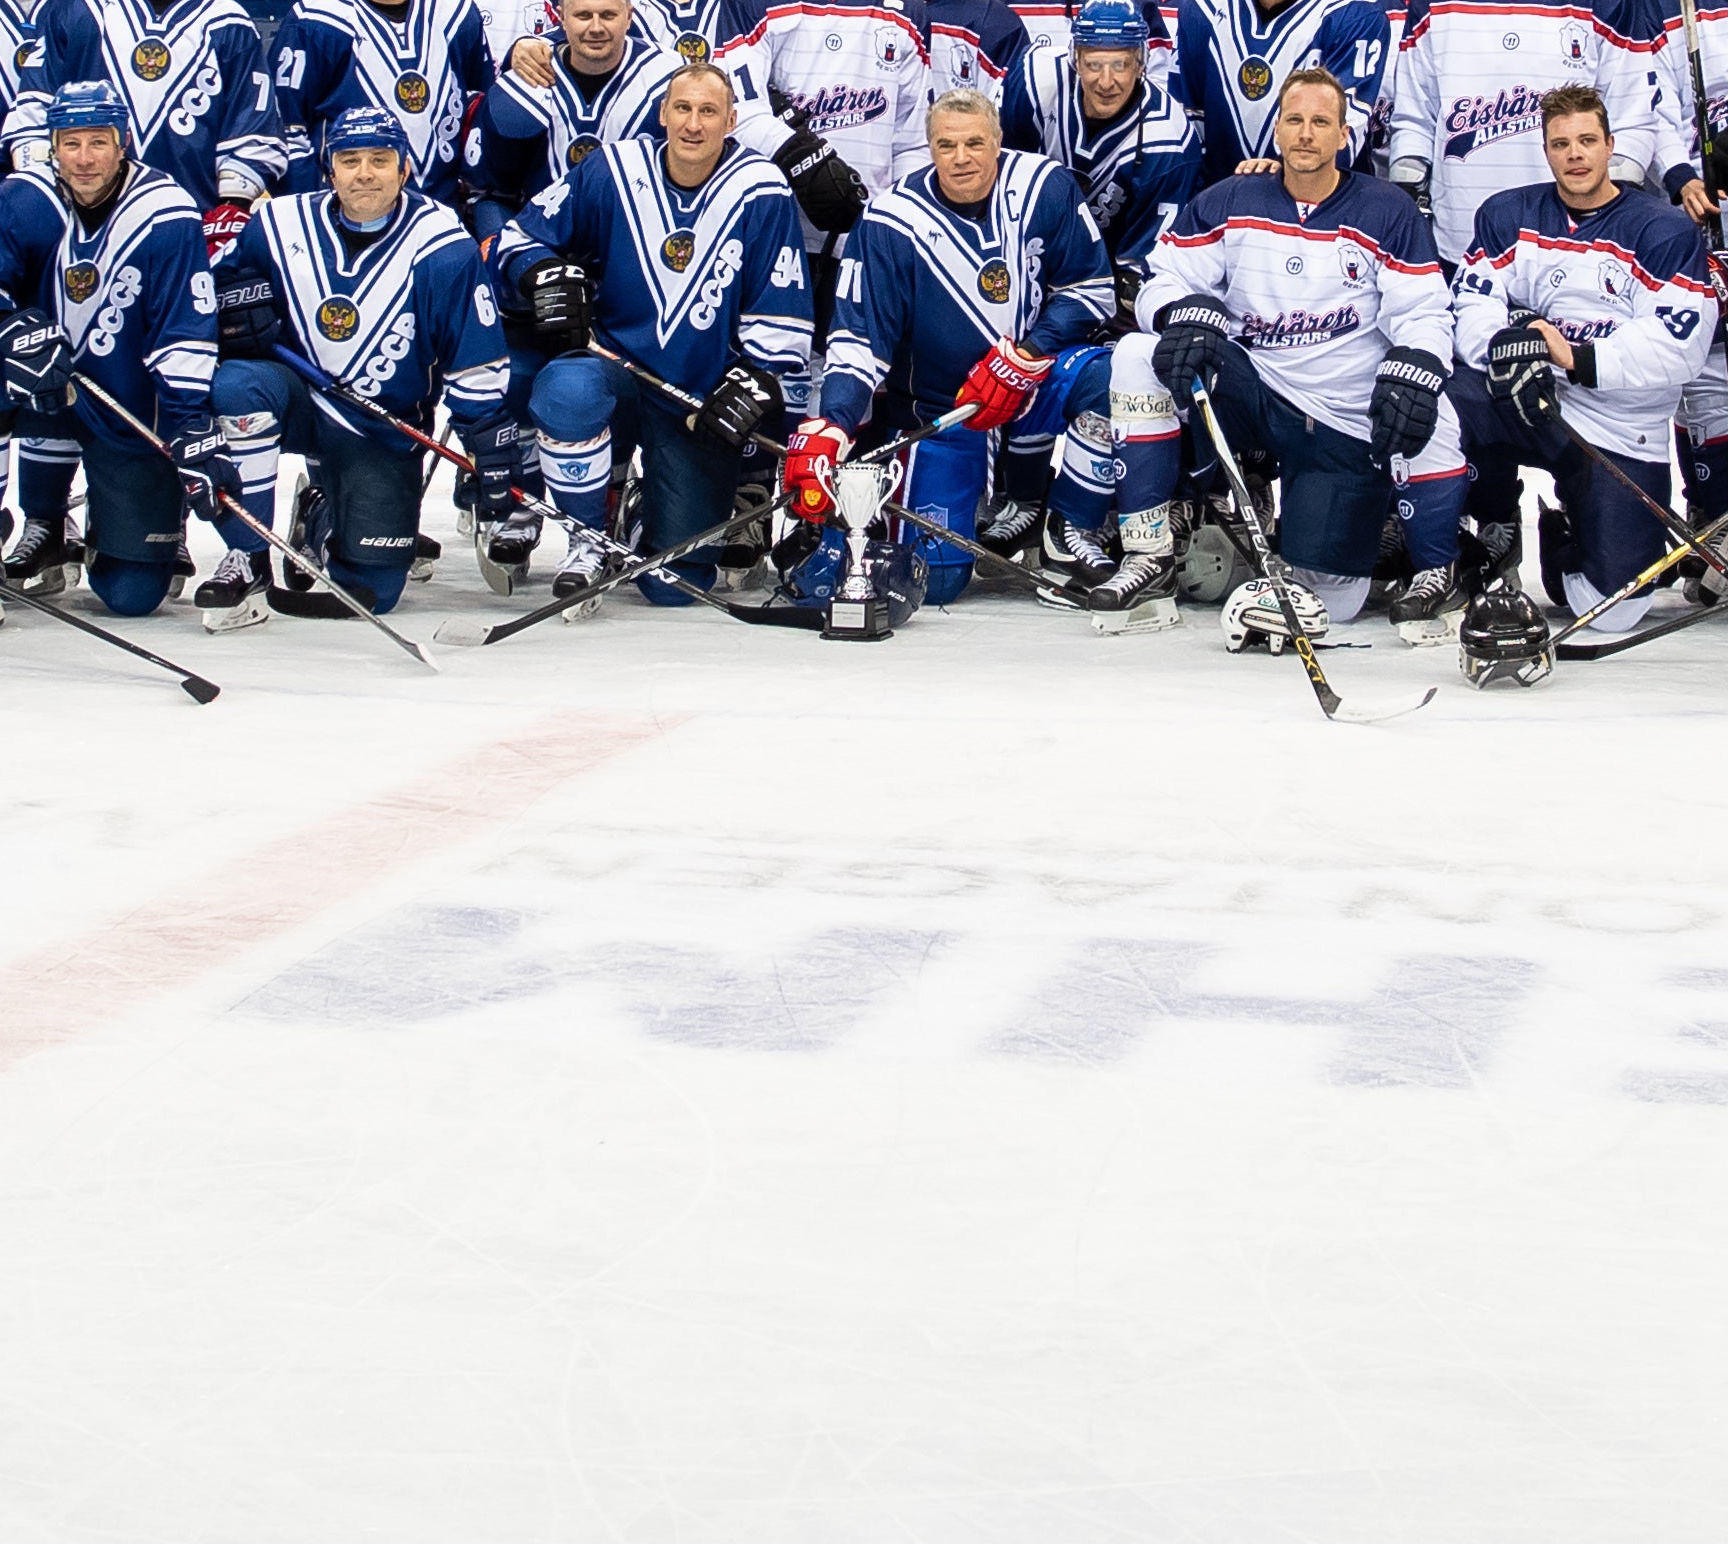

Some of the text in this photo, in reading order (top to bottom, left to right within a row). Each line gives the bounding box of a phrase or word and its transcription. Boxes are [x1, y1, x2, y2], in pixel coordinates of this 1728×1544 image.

[1355, 39, 1382, 78] 12
[1446, 85, 1546, 134] Eisbär
[535, 263, 586, 286] CC
[688, 238, 744, 331] СССР
[770, 246, 806, 291] 94
[88, 265, 143, 356] СССР
[1167, 305, 1231, 338] WARRIO
[351, 312, 417, 398] СССР
